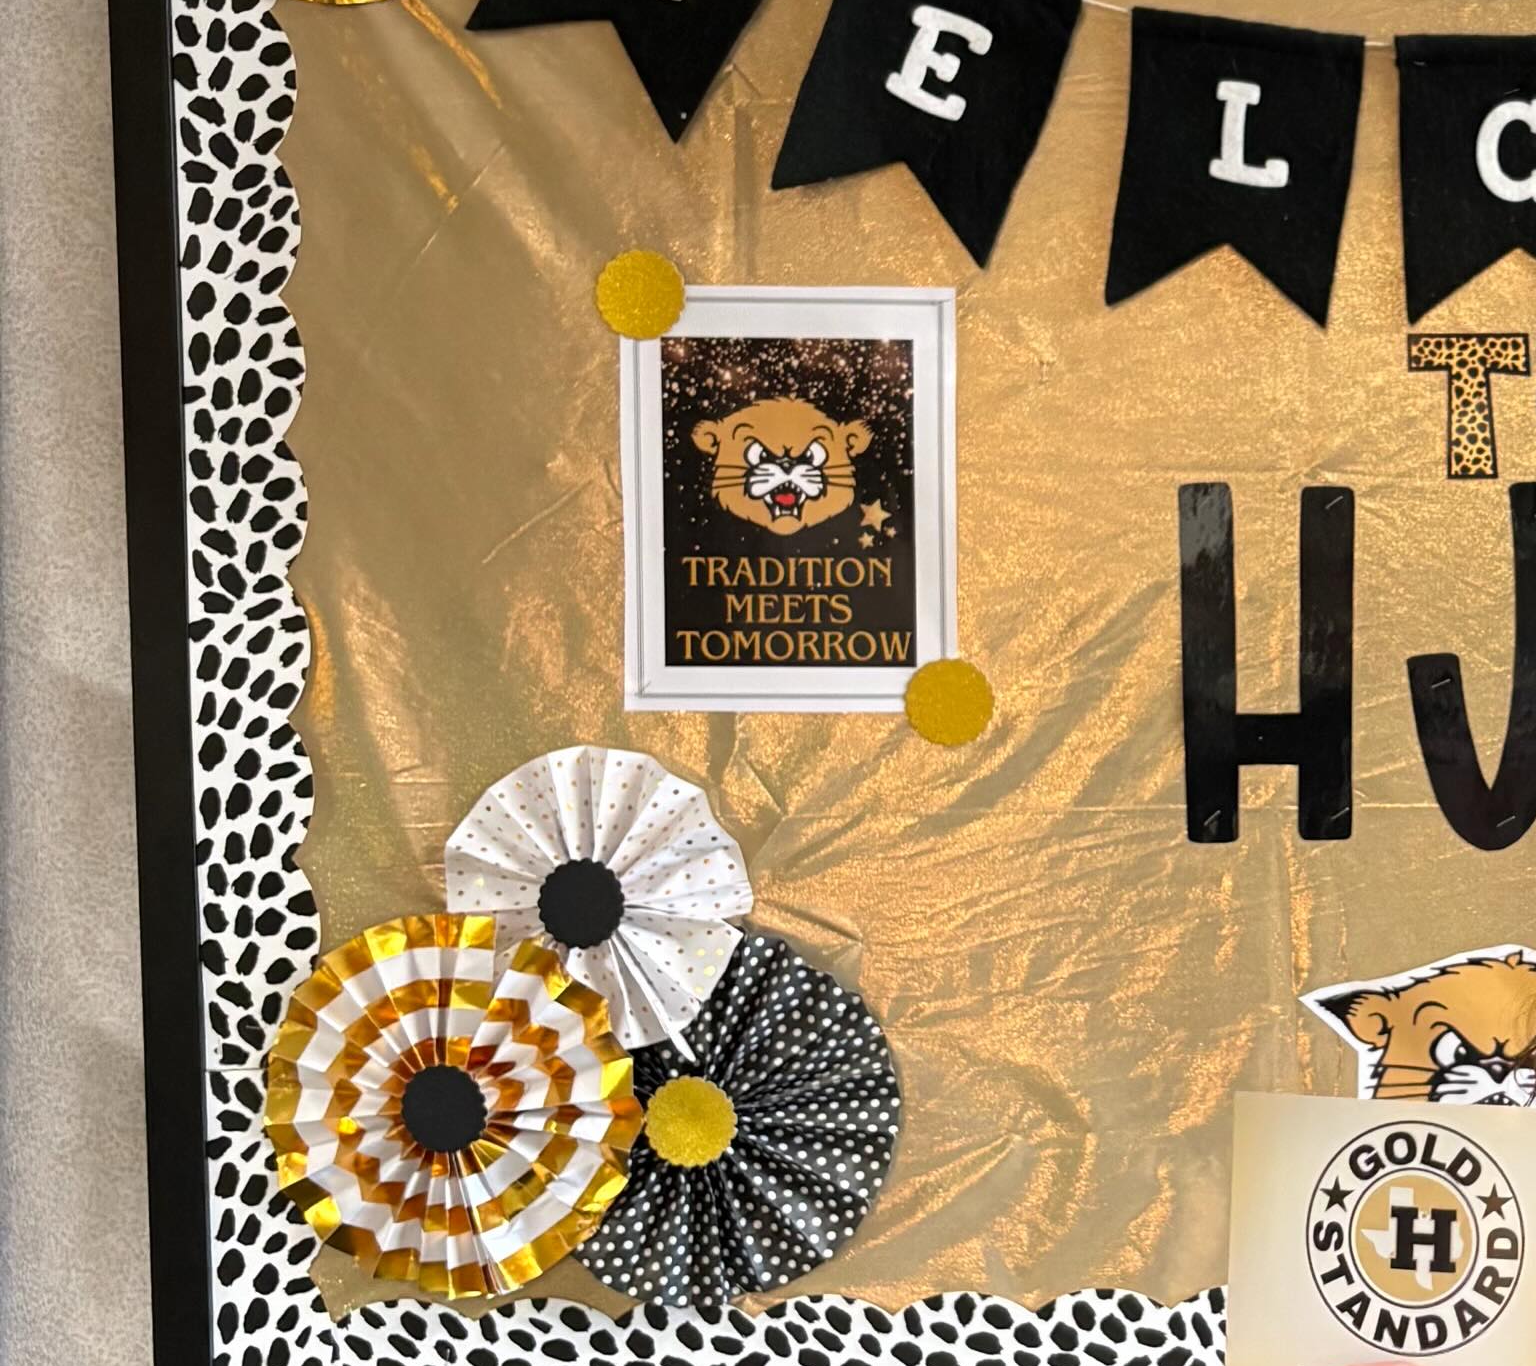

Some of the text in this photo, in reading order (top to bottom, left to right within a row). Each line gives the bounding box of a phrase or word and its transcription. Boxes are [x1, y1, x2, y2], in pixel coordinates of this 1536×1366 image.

[682, 556, 893, 589] TRADITION
[725, 593, 853, 624] MEETS
[676, 630, 913, 661] TOMORROW
[1348, 1131, 1483, 1188] GOLD
[1390, 1205, 1458, 1274] H
[1313, 1219, 1519, 1352] STANDARD
